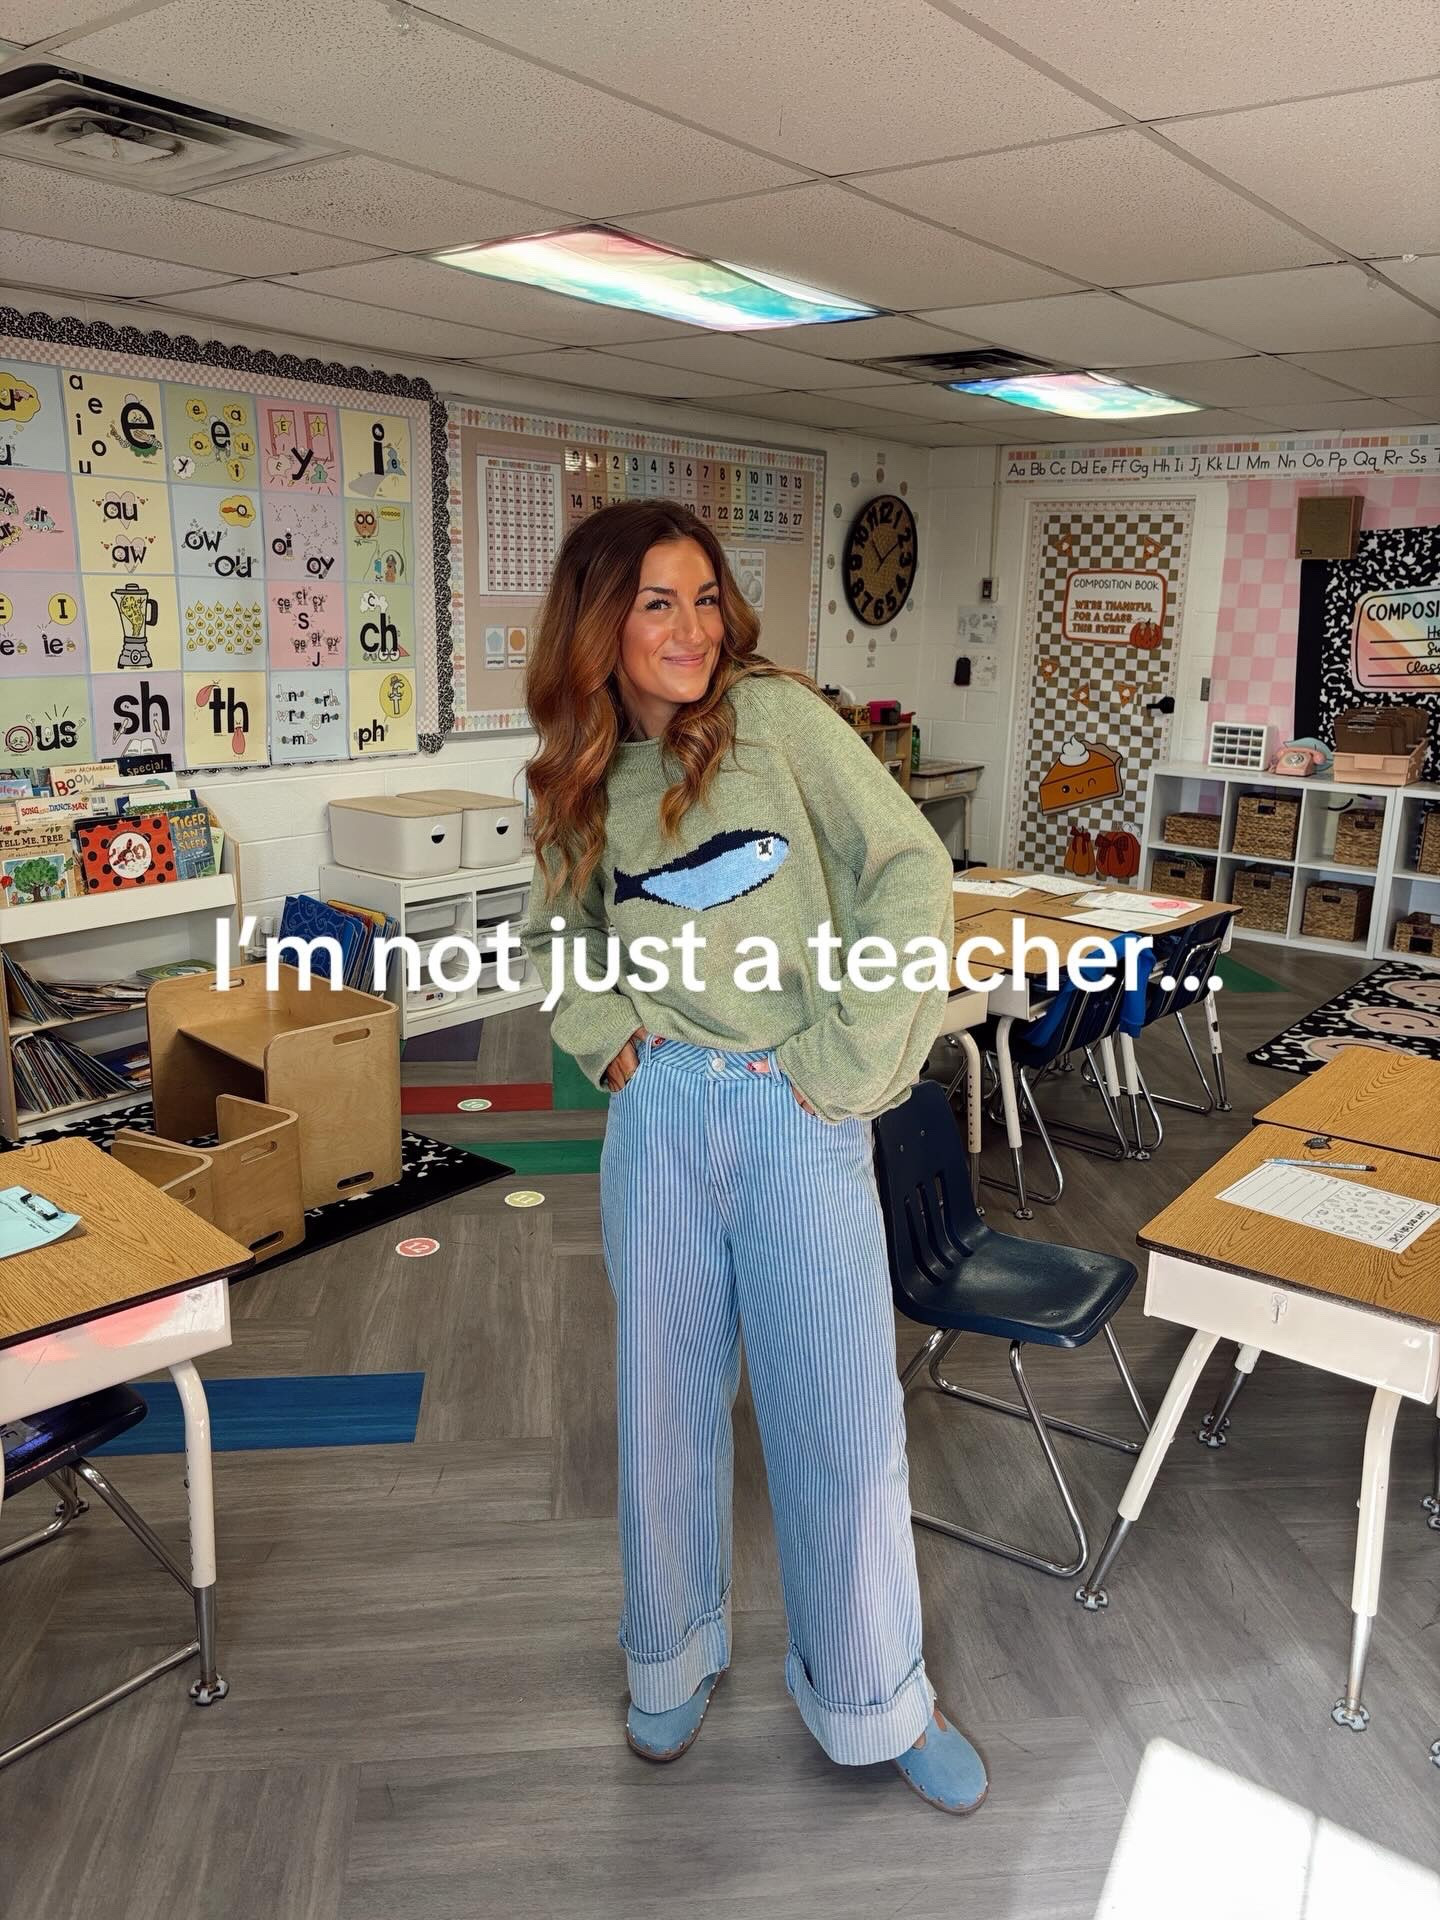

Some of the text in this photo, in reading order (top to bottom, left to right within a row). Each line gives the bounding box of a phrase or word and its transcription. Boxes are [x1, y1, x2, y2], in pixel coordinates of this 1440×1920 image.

[69, 374, 83, 390] a
[88, 397, 103, 414] e
[192, 405, 200, 415] e
[231, 410, 241, 421] a
[76, 413, 82, 435] i
[121, 402, 154, 449] e
[281, 418, 287, 428] E
[211, 421, 230, 448] e
[92, 440, 107, 456] o
[194, 440, 203, 450] o
[372, 423, 385, 475] i
[79, 460, 92, 474] u
[178, 458, 188, 473] y
[234, 464, 239, 477] i
[275, 461, 282, 471] E
[291, 447, 314, 481] y
[391, 459, 398, 469] e
[594, 453, 599, 467] 1
[613, 455, 620, 469] 2
[632, 457, 639, 471] 3
[650, 459, 657, 473] 4
[669, 461, 675, 474] 5
[686, 464, 692, 477] 6
[703, 466, 709, 478] 7
[720, 467, 725, 480] 8
[736, 469, 741, 482] 9
[750, 471, 759, 484] 10
[766, 473, 773, 485] 11
[780, 475, 788, 487] 12
[794, 477, 802, 489] 13
[1008, 463, 1025, 476] Aa
[1030, 463, 1046, 476] Bb
[1050, 462, 1066, 476] Cc
[1071, 461, 1088, 474] Dd
[1092, 460, 1107, 474] Ee
[1112, 459, 1127, 473] Ff
[1130, 459, 1149, 479] Gg
[1153, 458, 1170, 473] Hh
[1174, 458, 1183, 473] Ii
[1188, 457, 1200, 477] Jj
[1207, 456, 1222, 471] Kk
[1226, 456, 1240, 470] Ll
[1247, 456, 1270, 470] Mm
[1278, 454, 1296, 469] Nn
[1303, 453, 1324, 467] Oo
[1329, 452, 1347, 472] Pp
[1354, 451, 1380, 472] Qq
[1383, 449, 1403, 465] Rr
[1409, 449, 1427, 464] Ss
[104, 501, 138, 521] au
[571, 495, 582, 508] 14
[592, 496, 602, 510] 15
[702, 505, 711, 518] 21
[718, 507, 728, 520] 22
[733, 507, 743, 520] 23
[749, 509, 759, 521] 24
[764, 511, 773, 523] 25
[778, 512, 788, 524] 26
[793, 514, 802, 525] 27
[866, 507, 878, 532] 11
[880, 501, 894, 523] 12
[893, 510, 902, 529] 1
[185, 531, 222, 552] ow
[272, 533, 292, 556] oi
[112, 545, 147, 564] aw
[215, 555, 252, 578] ou
[307, 556, 335, 579] oy
[1074, 579, 1160, 590] COMPOSITION BOOK
[57, 599, 68, 619] I
[277, 598, 290, 607] ce
[861, 590, 874, 613] 7
[874, 599, 884, 619] 6
[886, 589, 896, 611] 5
[1075, 600, 1153, 612] WE'RE THANKFUL
[298, 612, 309, 629] S
[1073, 611, 1133, 623] FOR A CLASS
[1367, 600, 1440, 621] COMPOSI
[360, 613, 398, 653] ch
[1072, 623, 1126, 634] THIS SWEET
[42, 634, 63, 655] ie
[312, 652, 320, 667] J
[113, 681, 170, 735] sh
[209, 687, 249, 733] th
[358, 719, 385, 750] ph
[55, 774, 95, 796] BOOM
[21, 807, 39, 816] SONG
[49, 803, 72, 812] DANCE
[72, 803, 88, 811] MAN
[170, 813, 206, 828] TIGER
[40, 834, 63, 842] TREE
[179, 839, 208, 851] SLEEP
